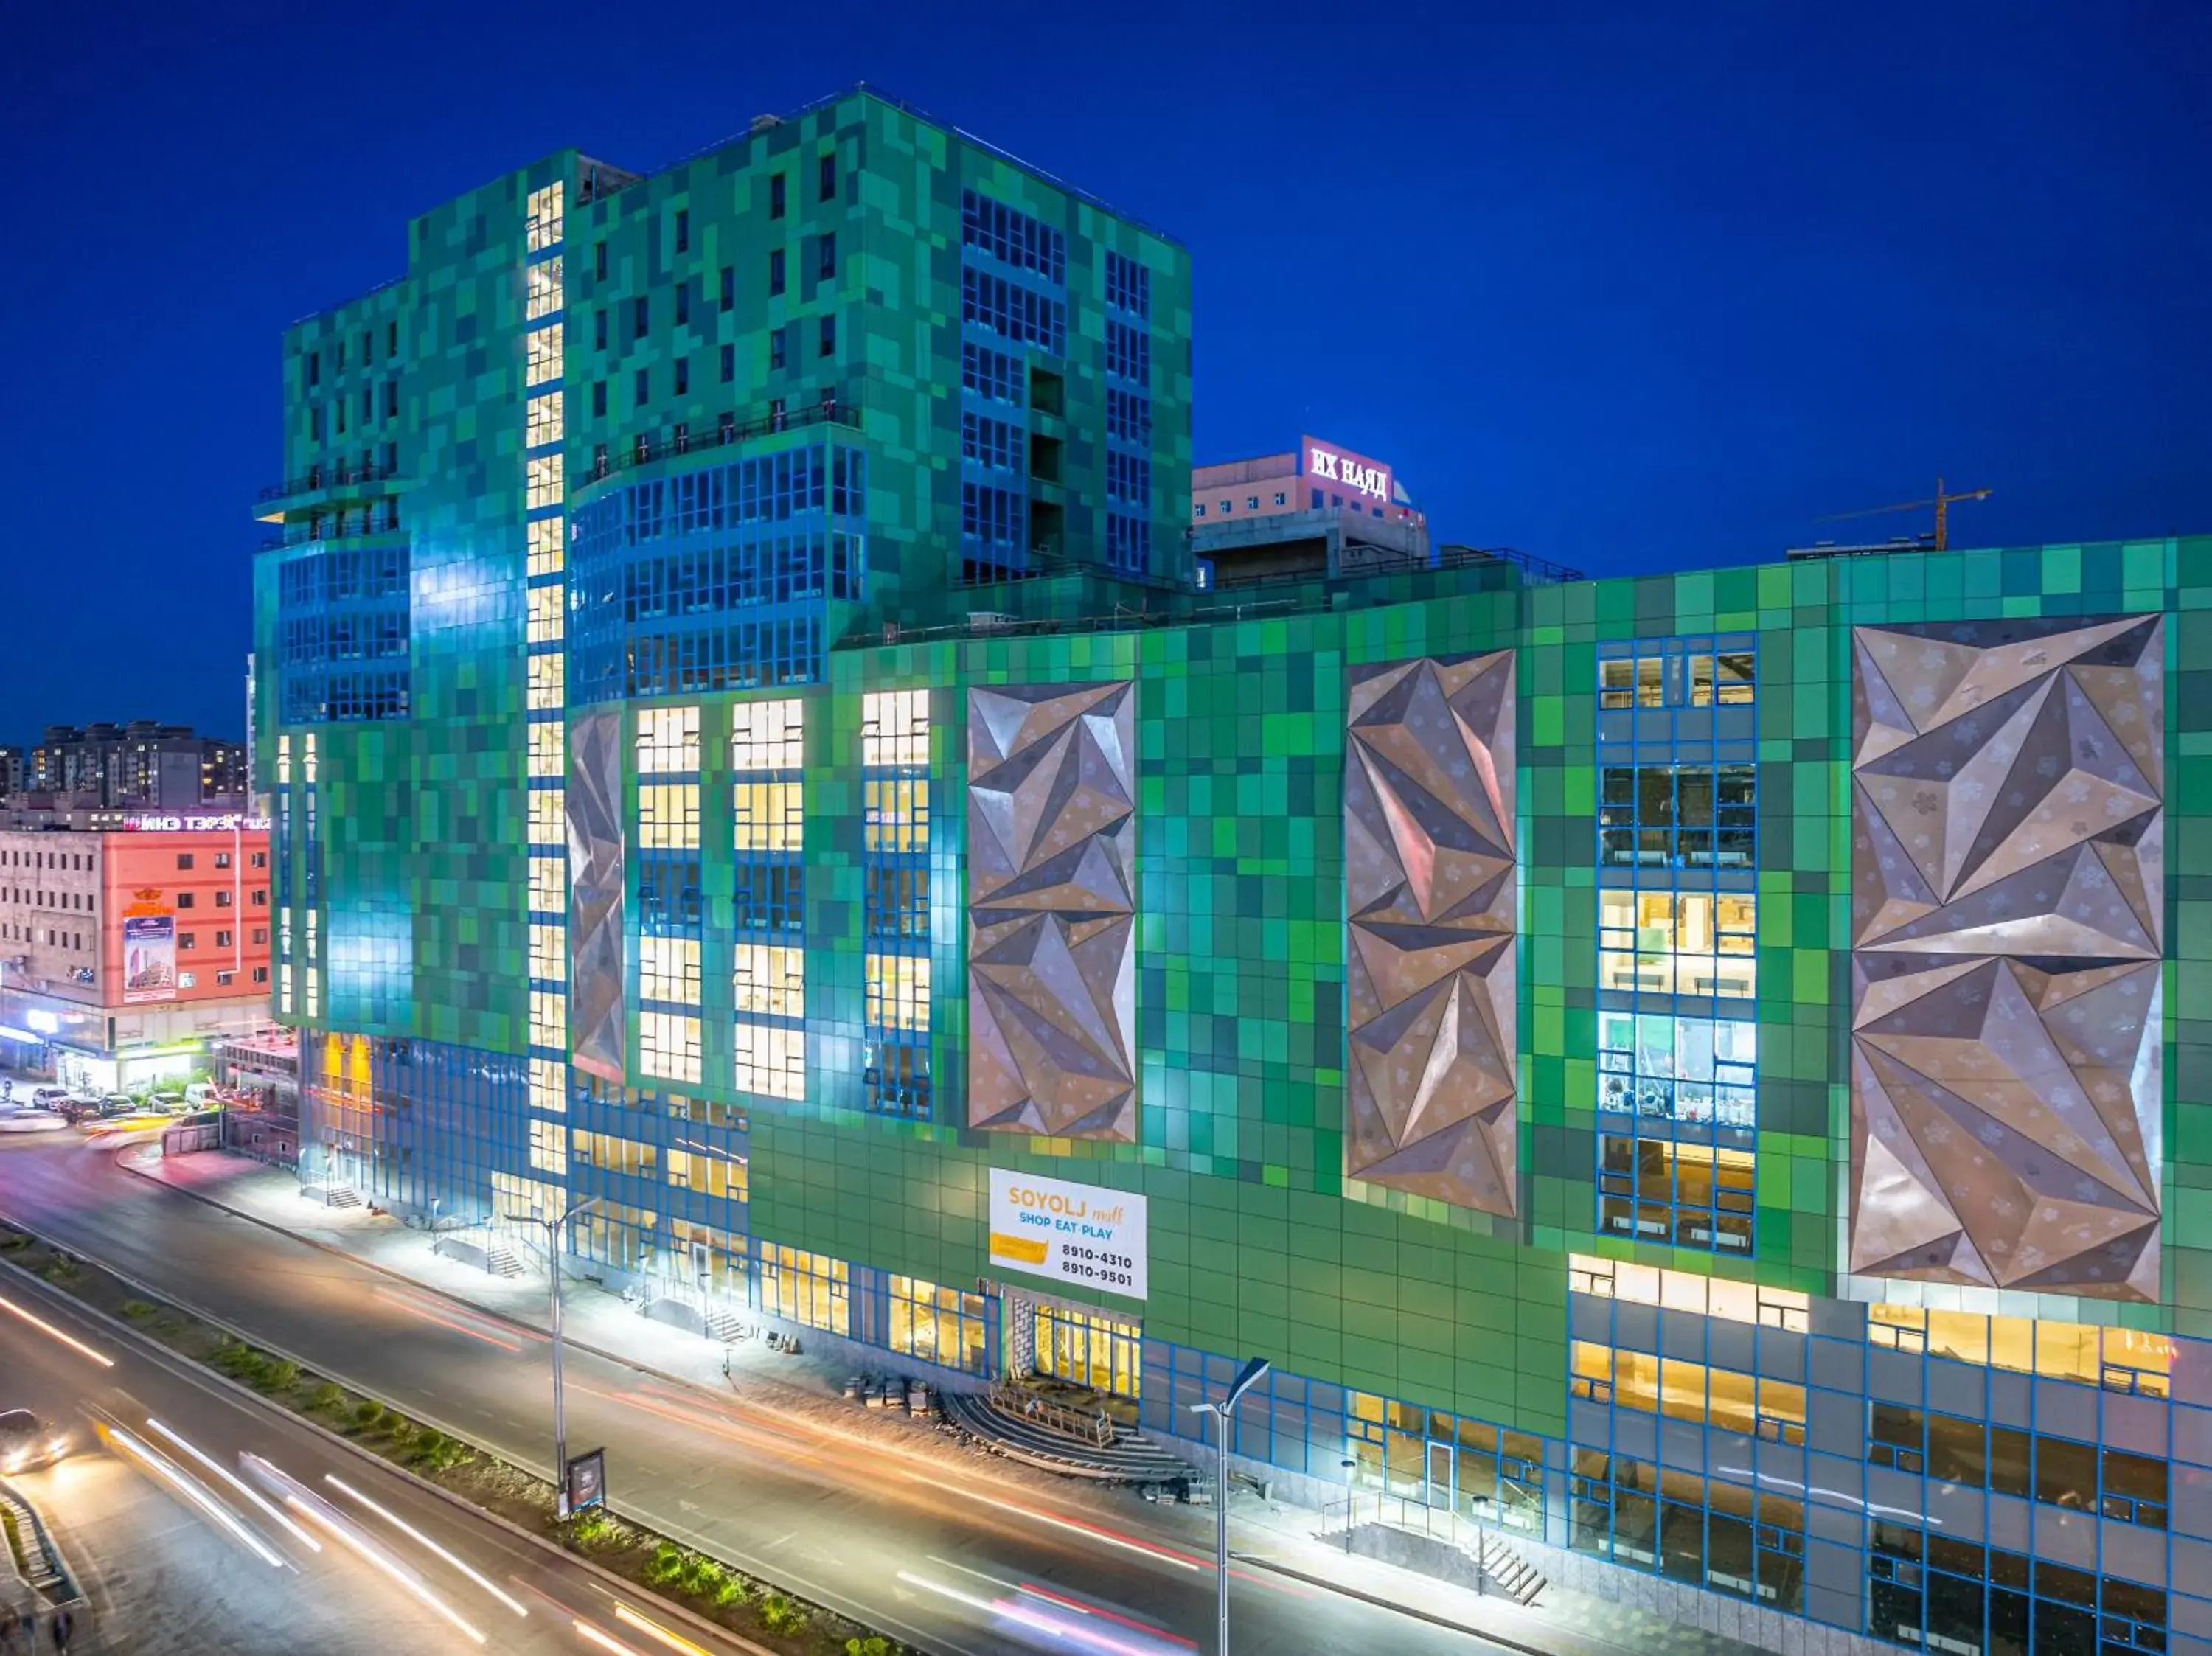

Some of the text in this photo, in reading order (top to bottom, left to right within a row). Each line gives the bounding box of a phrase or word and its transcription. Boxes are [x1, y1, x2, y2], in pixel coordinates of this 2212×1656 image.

[1340, 458, 1387, 502] НАЯД
[1009, 1186, 1087, 1217] SOYOLJ
[1020, 1211, 1113, 1239] SHOP EAT PLAY
[1062, 1244, 1132, 1268] 8910-4310
[1062, 1261, 1132, 1286] 8910-9501
